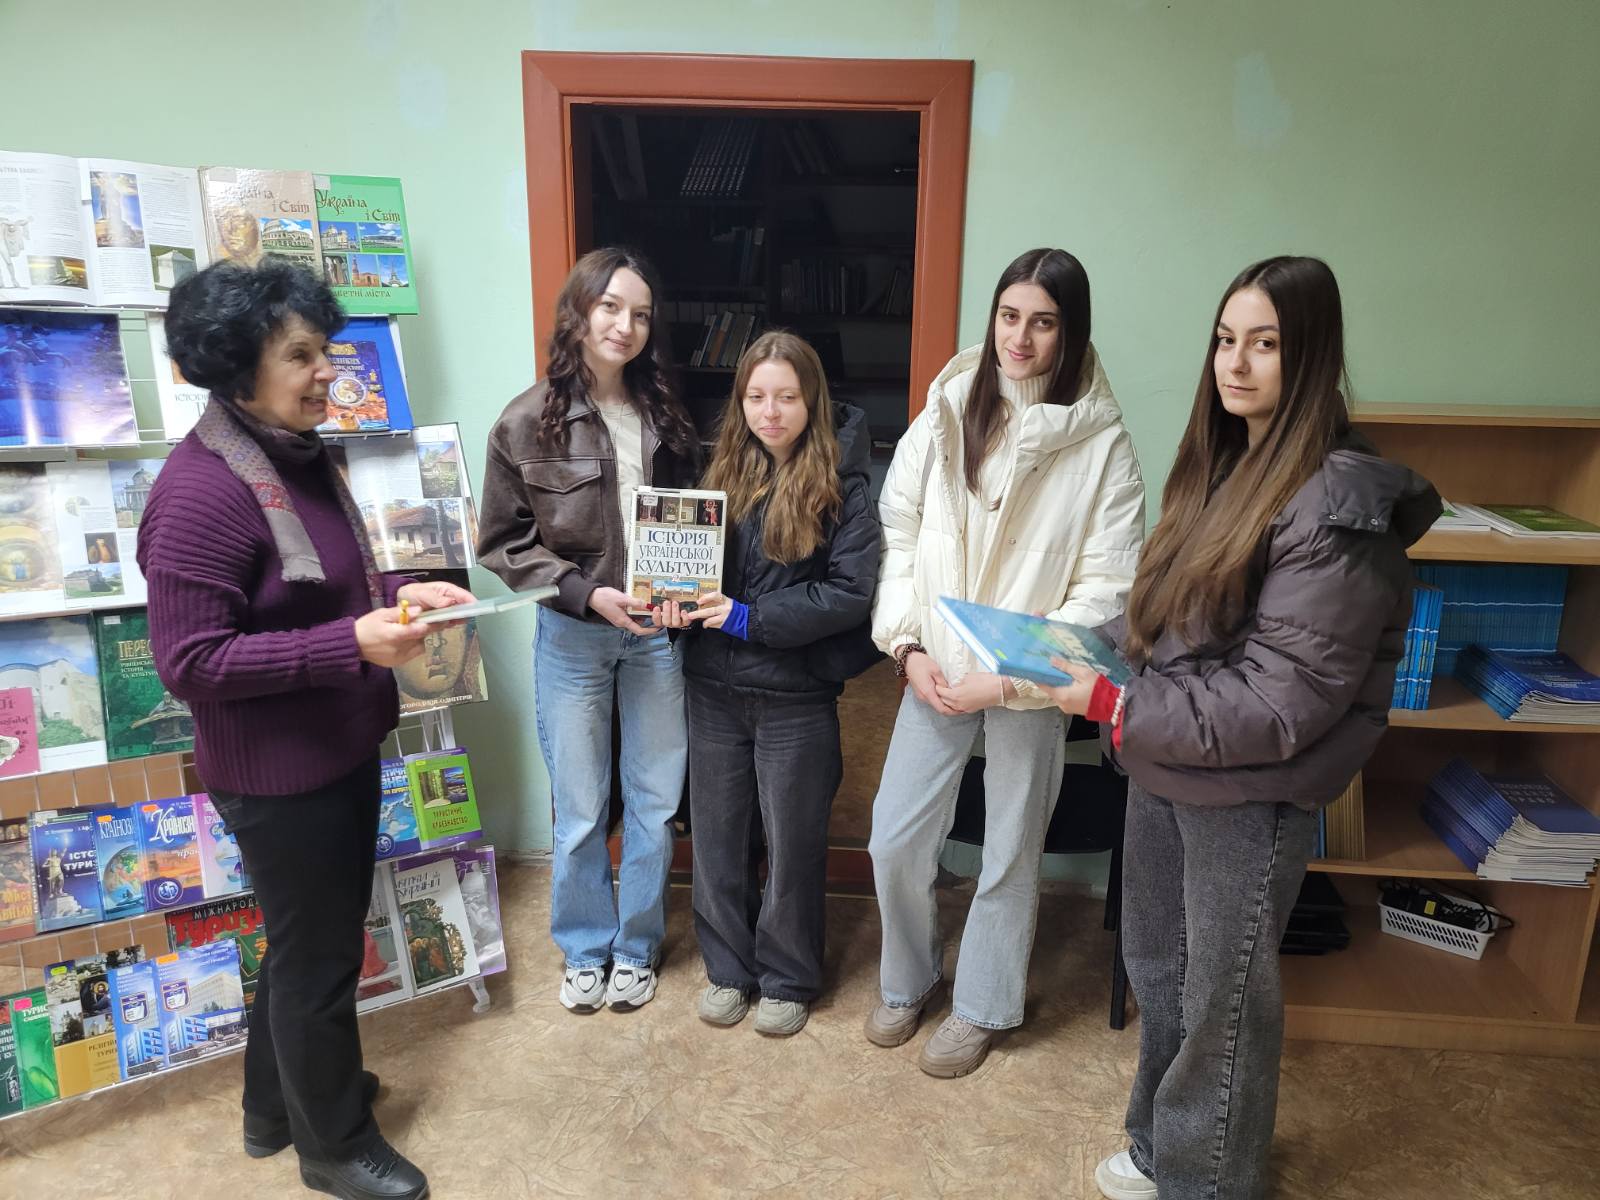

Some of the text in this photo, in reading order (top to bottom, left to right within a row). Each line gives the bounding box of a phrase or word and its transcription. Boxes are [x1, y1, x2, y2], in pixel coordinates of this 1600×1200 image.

[647, 530, 709, 546] ІСТОРІЯ
[639, 544, 713, 561] УКРАЇНСЬКОЇ
[635, 559, 717, 576] КУЛЬТУРИ
[118, 639, 153, 658] ПЕРЕС
[99, 817, 134, 839] КРАЇНОЗ
[149, 807, 195, 843] КРАЇНОЗН
[64, 860, 95, 871] ТУРИ
[194, 898, 255, 920] МІЖНАРОД
[22, 1004, 48, 1017] ТУРИС
